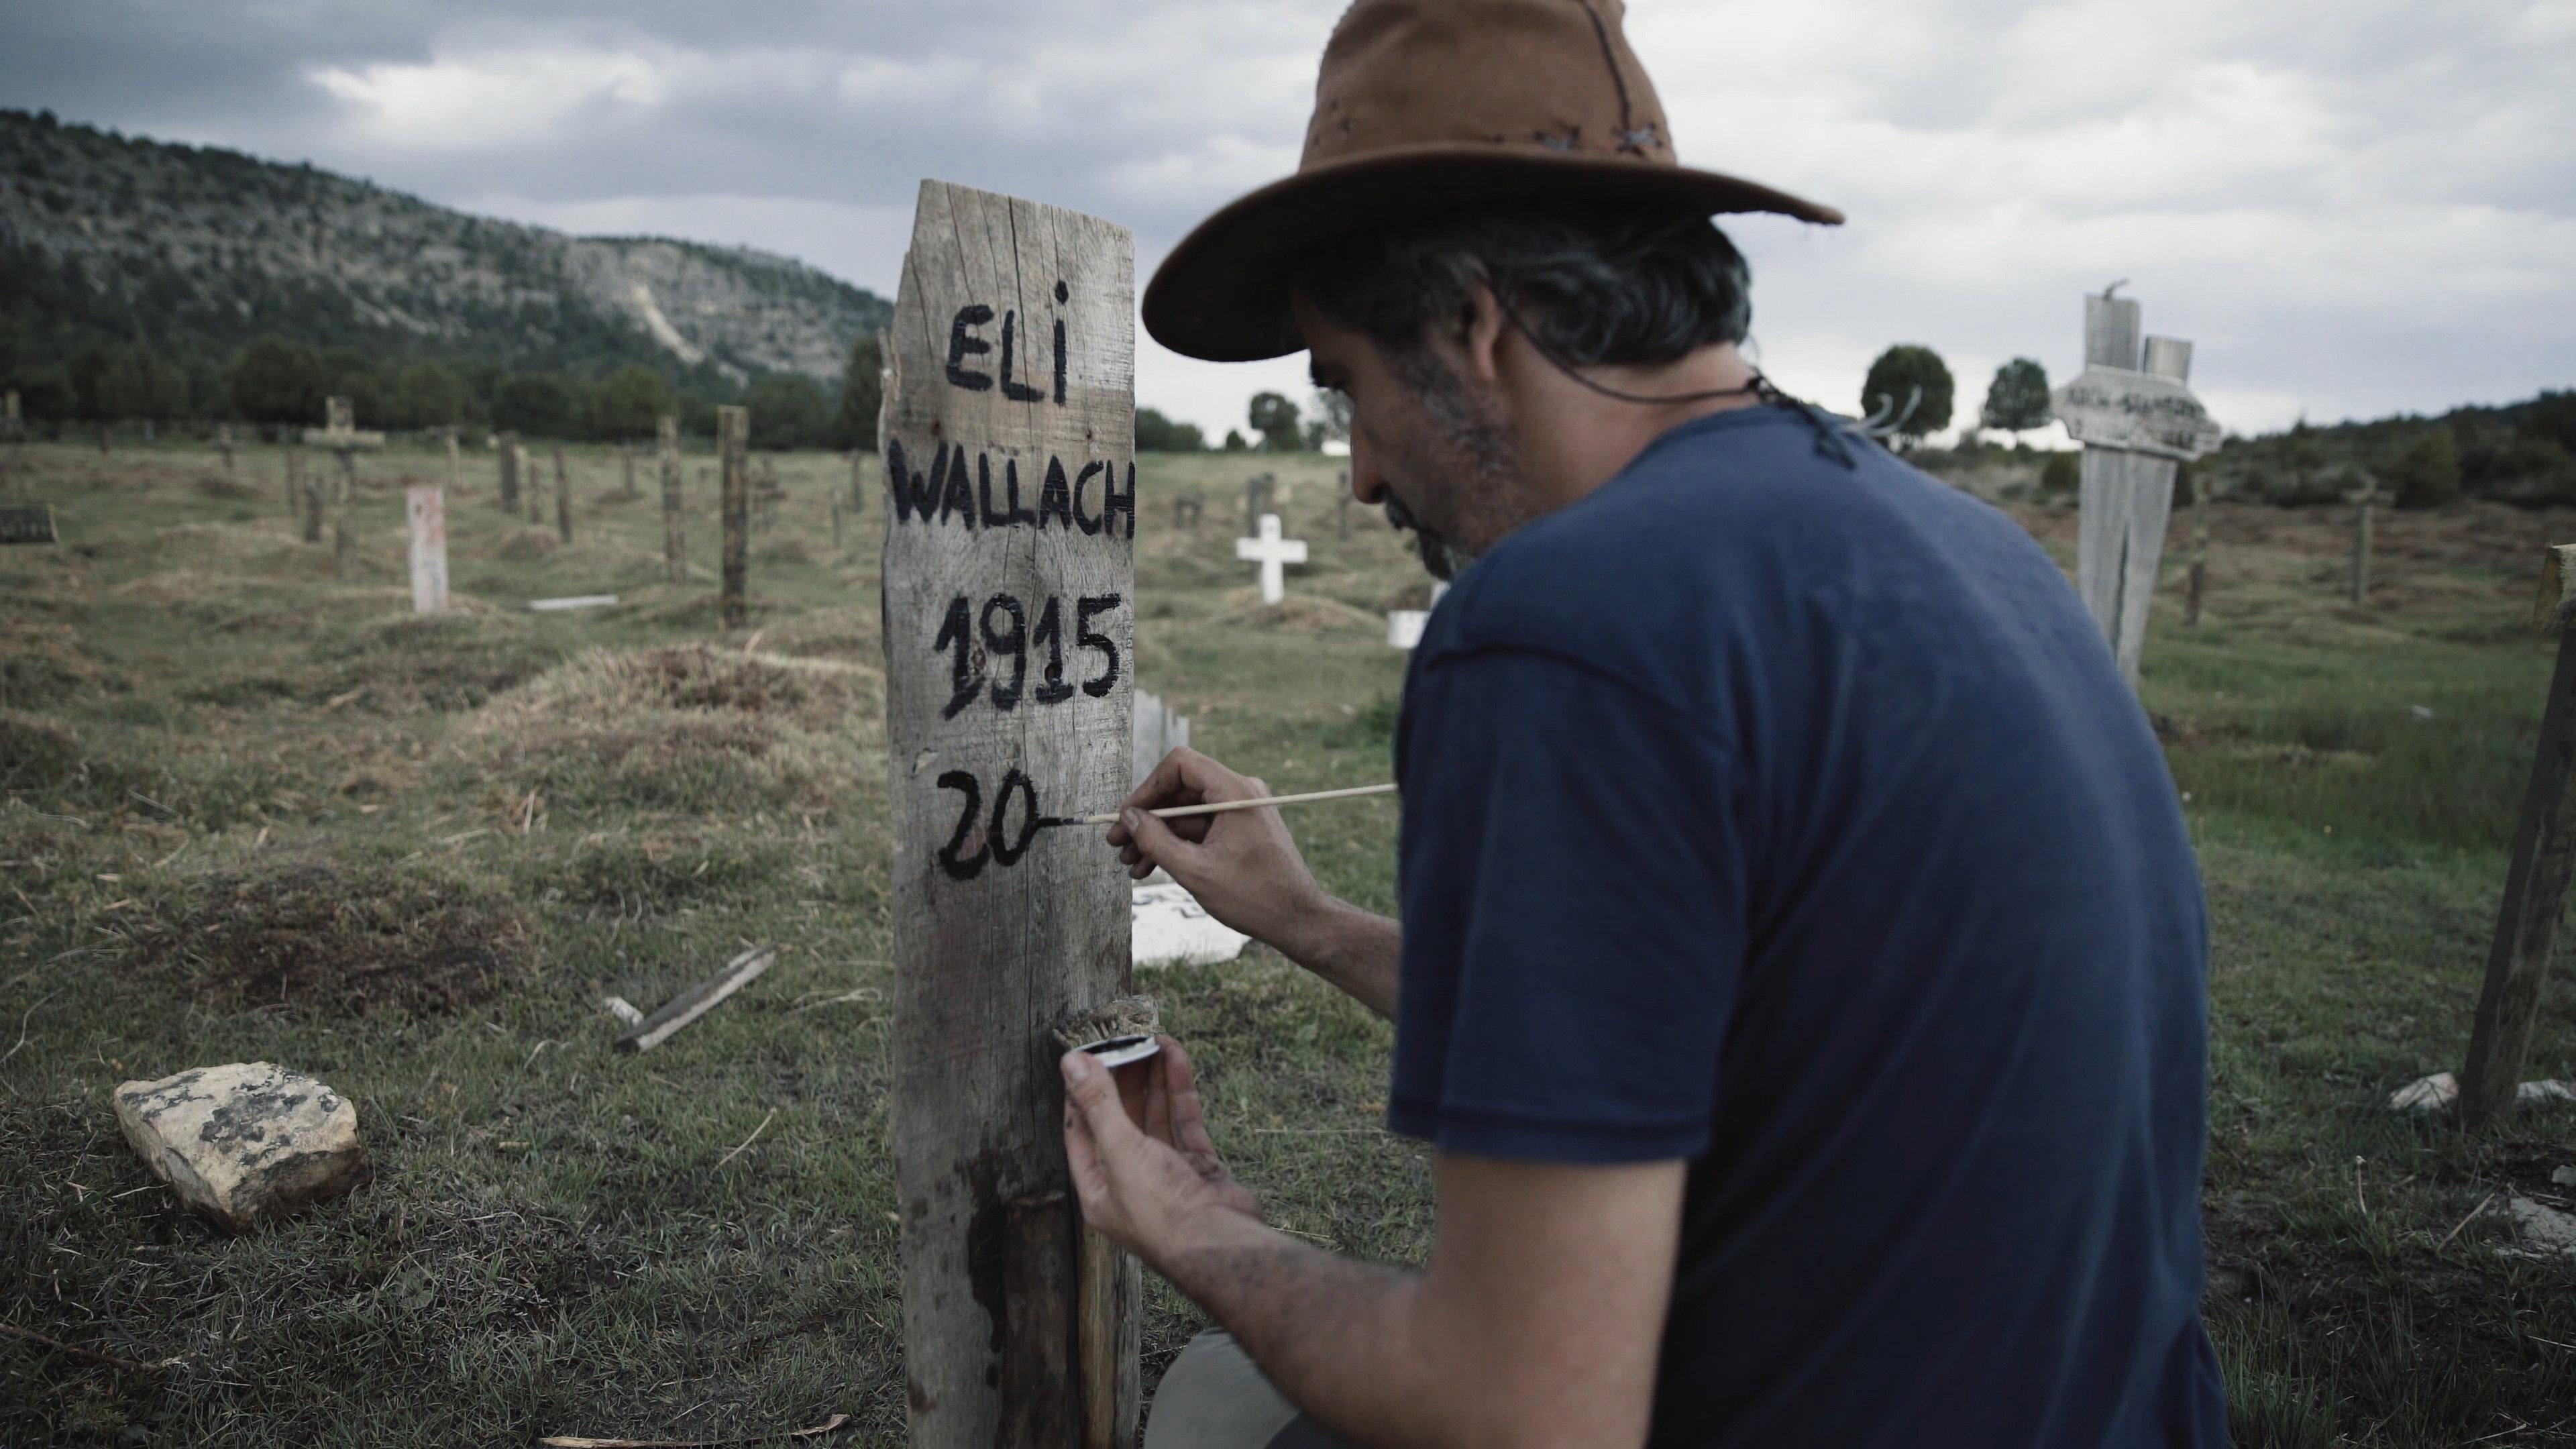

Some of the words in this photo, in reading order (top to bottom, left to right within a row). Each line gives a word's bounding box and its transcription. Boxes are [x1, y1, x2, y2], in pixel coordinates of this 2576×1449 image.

[888, 439, 1135, 538] WALLACH
[934, 593, 1121, 720] 1915
[938, 769, 1041, 881] 20
